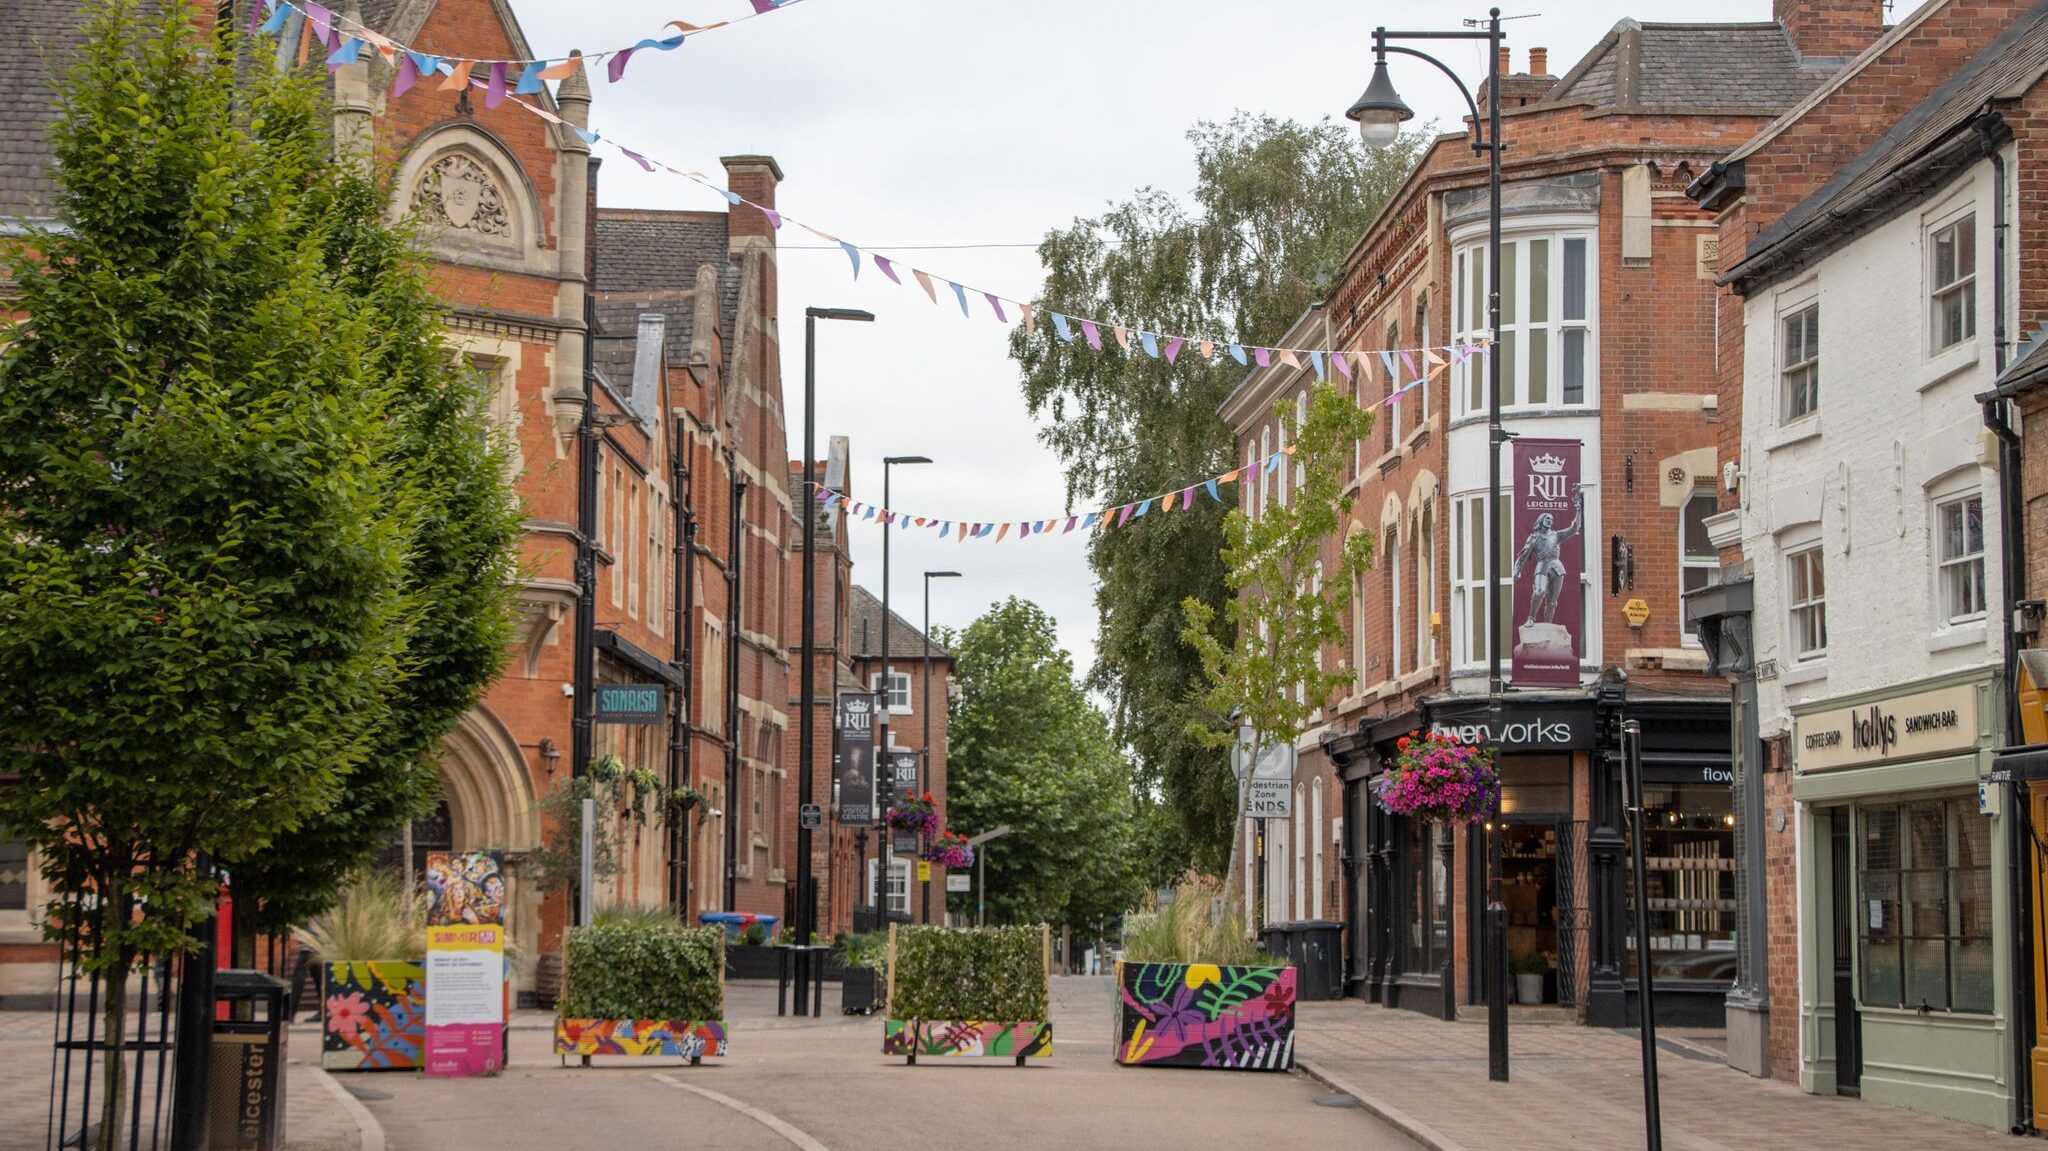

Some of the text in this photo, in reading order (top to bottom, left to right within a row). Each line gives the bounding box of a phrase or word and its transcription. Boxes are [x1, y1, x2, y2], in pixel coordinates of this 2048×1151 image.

[1526, 501, 1569, 509] LEICESTER
[601, 690, 657, 712] SONRISA
[1852, 706, 1896, 755] hollys
[1905, 710, 1956, 733] SANDWICH BAR
[1806, 730, 1841, 749] COFFEE SHOP
[1242, 781, 1289, 789] edestrian
[1255, 790, 1276, 798] Zone
